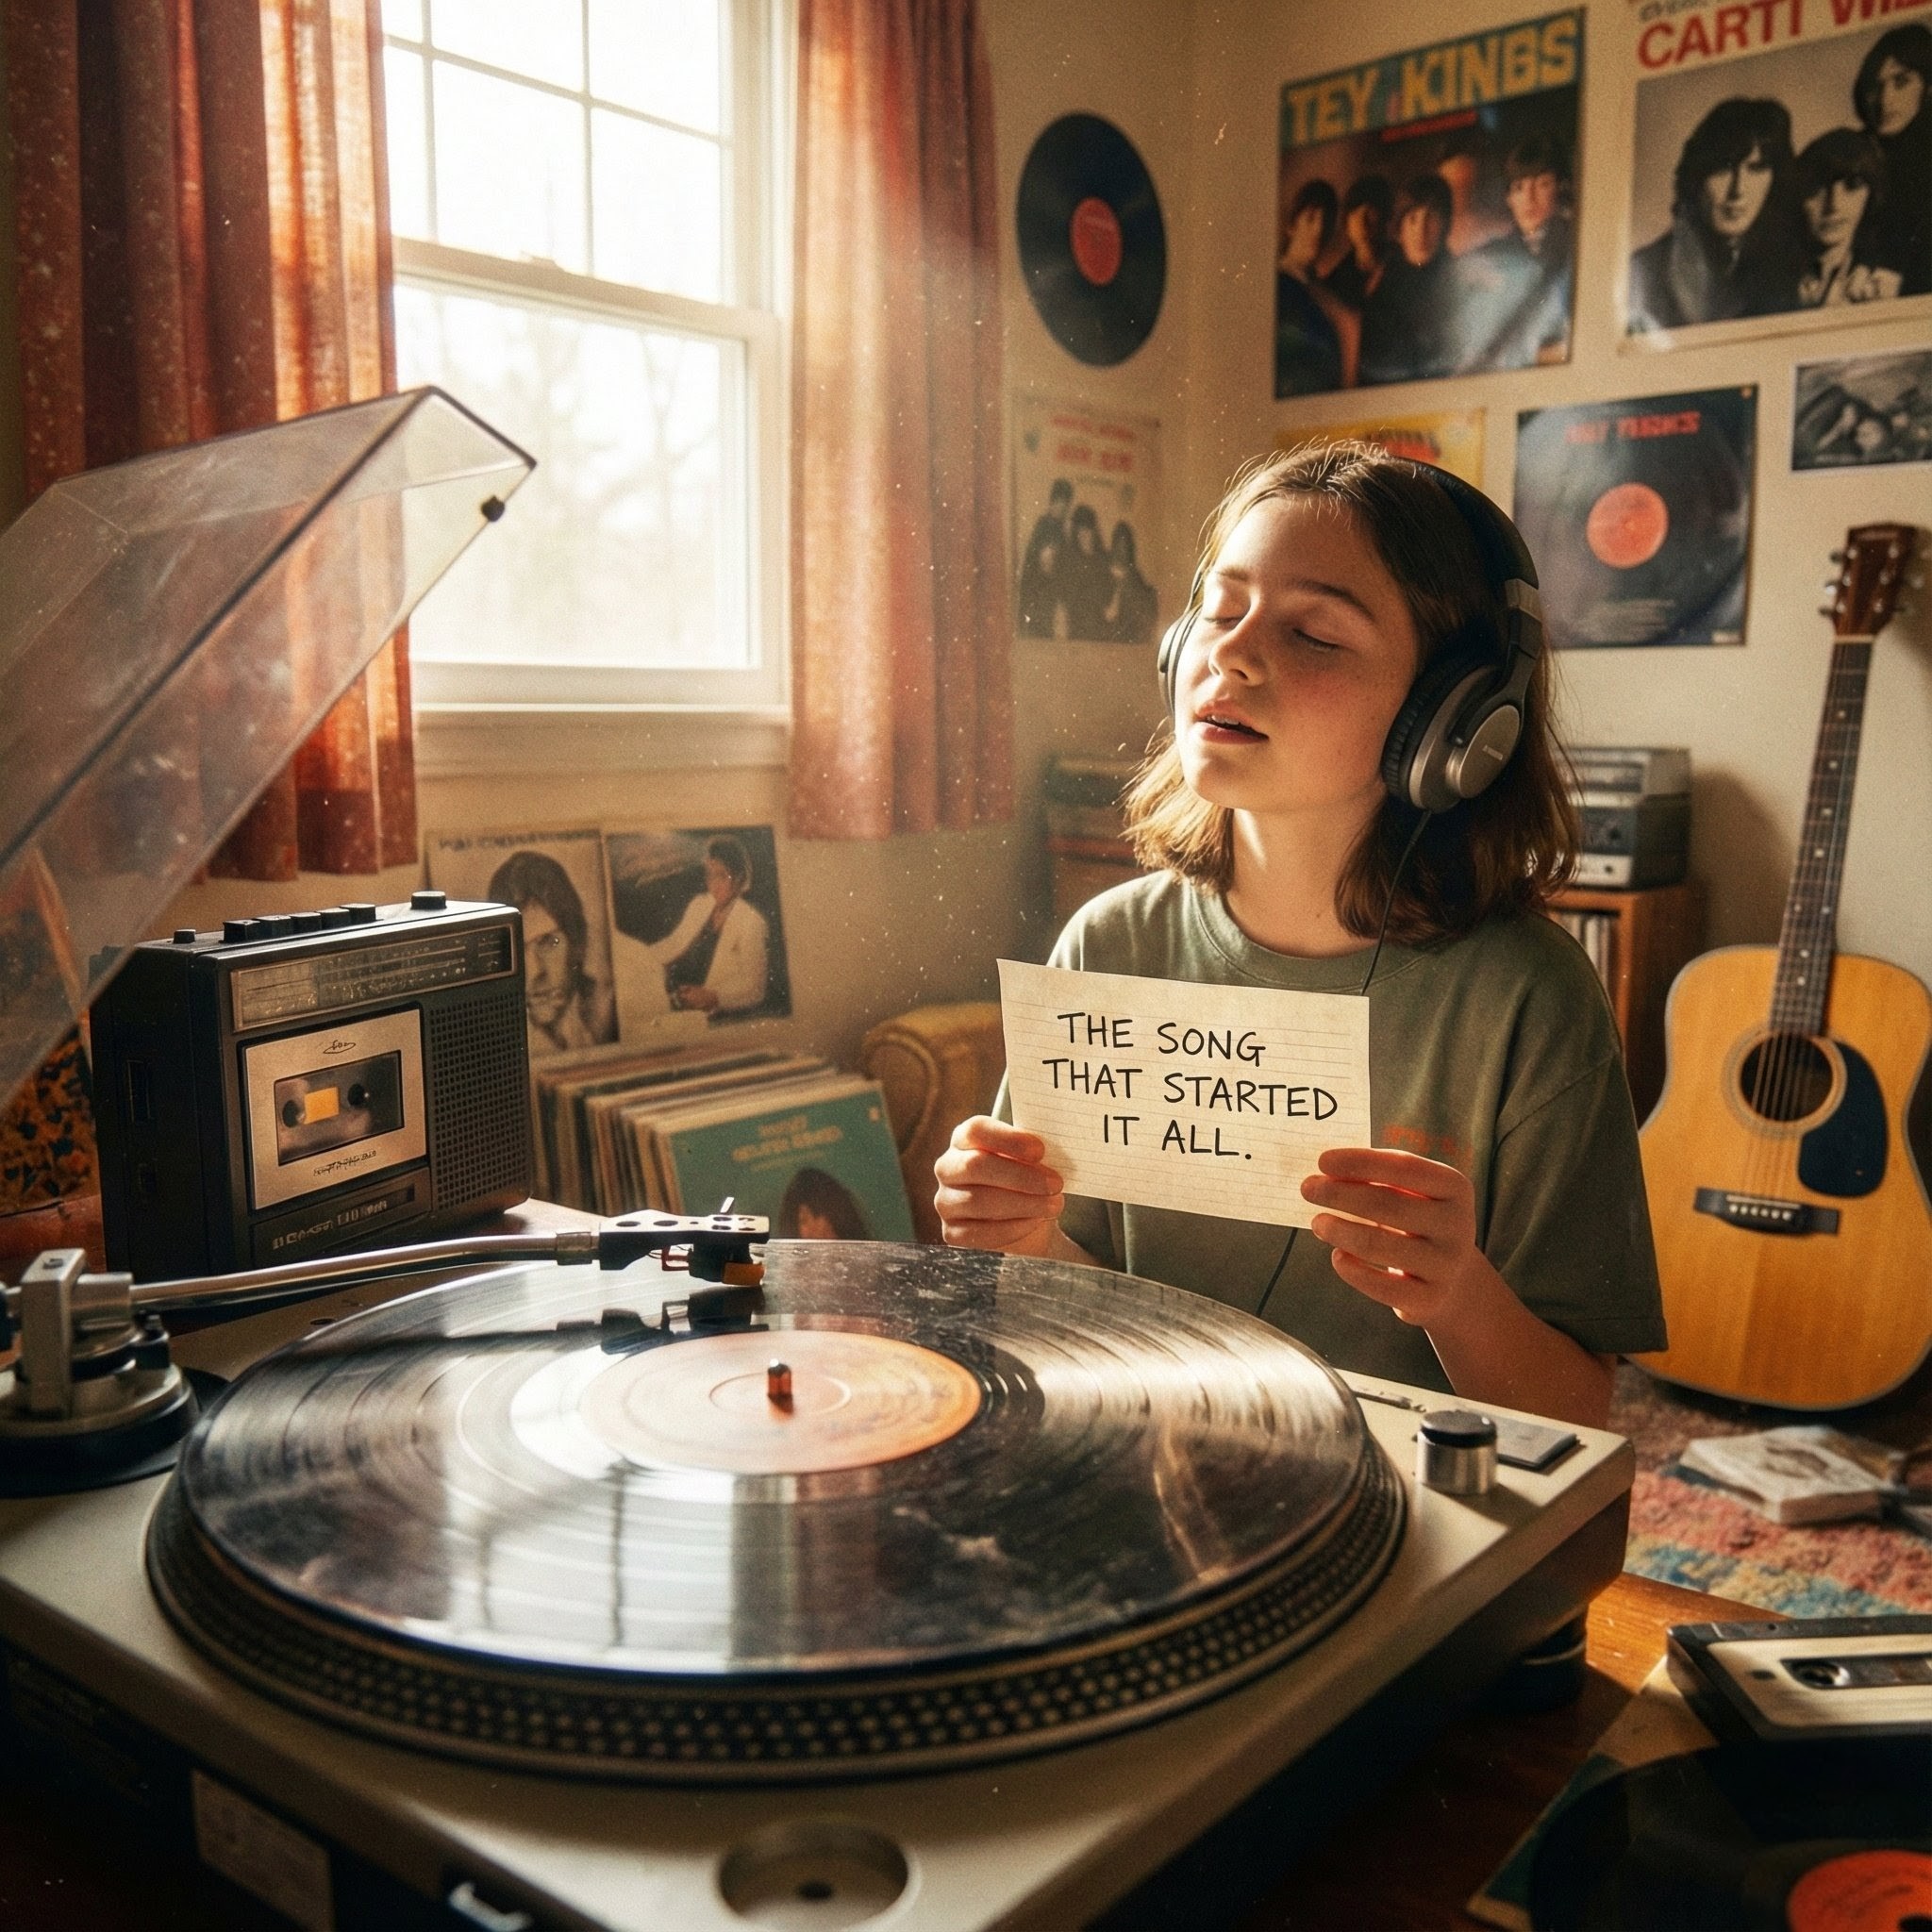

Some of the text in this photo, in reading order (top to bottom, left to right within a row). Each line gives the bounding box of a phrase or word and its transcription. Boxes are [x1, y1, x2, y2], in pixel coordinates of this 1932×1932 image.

[1057, 1011, 1266, 1068] THE SONG
[1041, 1058, 1338, 1121] THAT STARTED
[1104, 1114, 1252, 1160] IT ALL.
